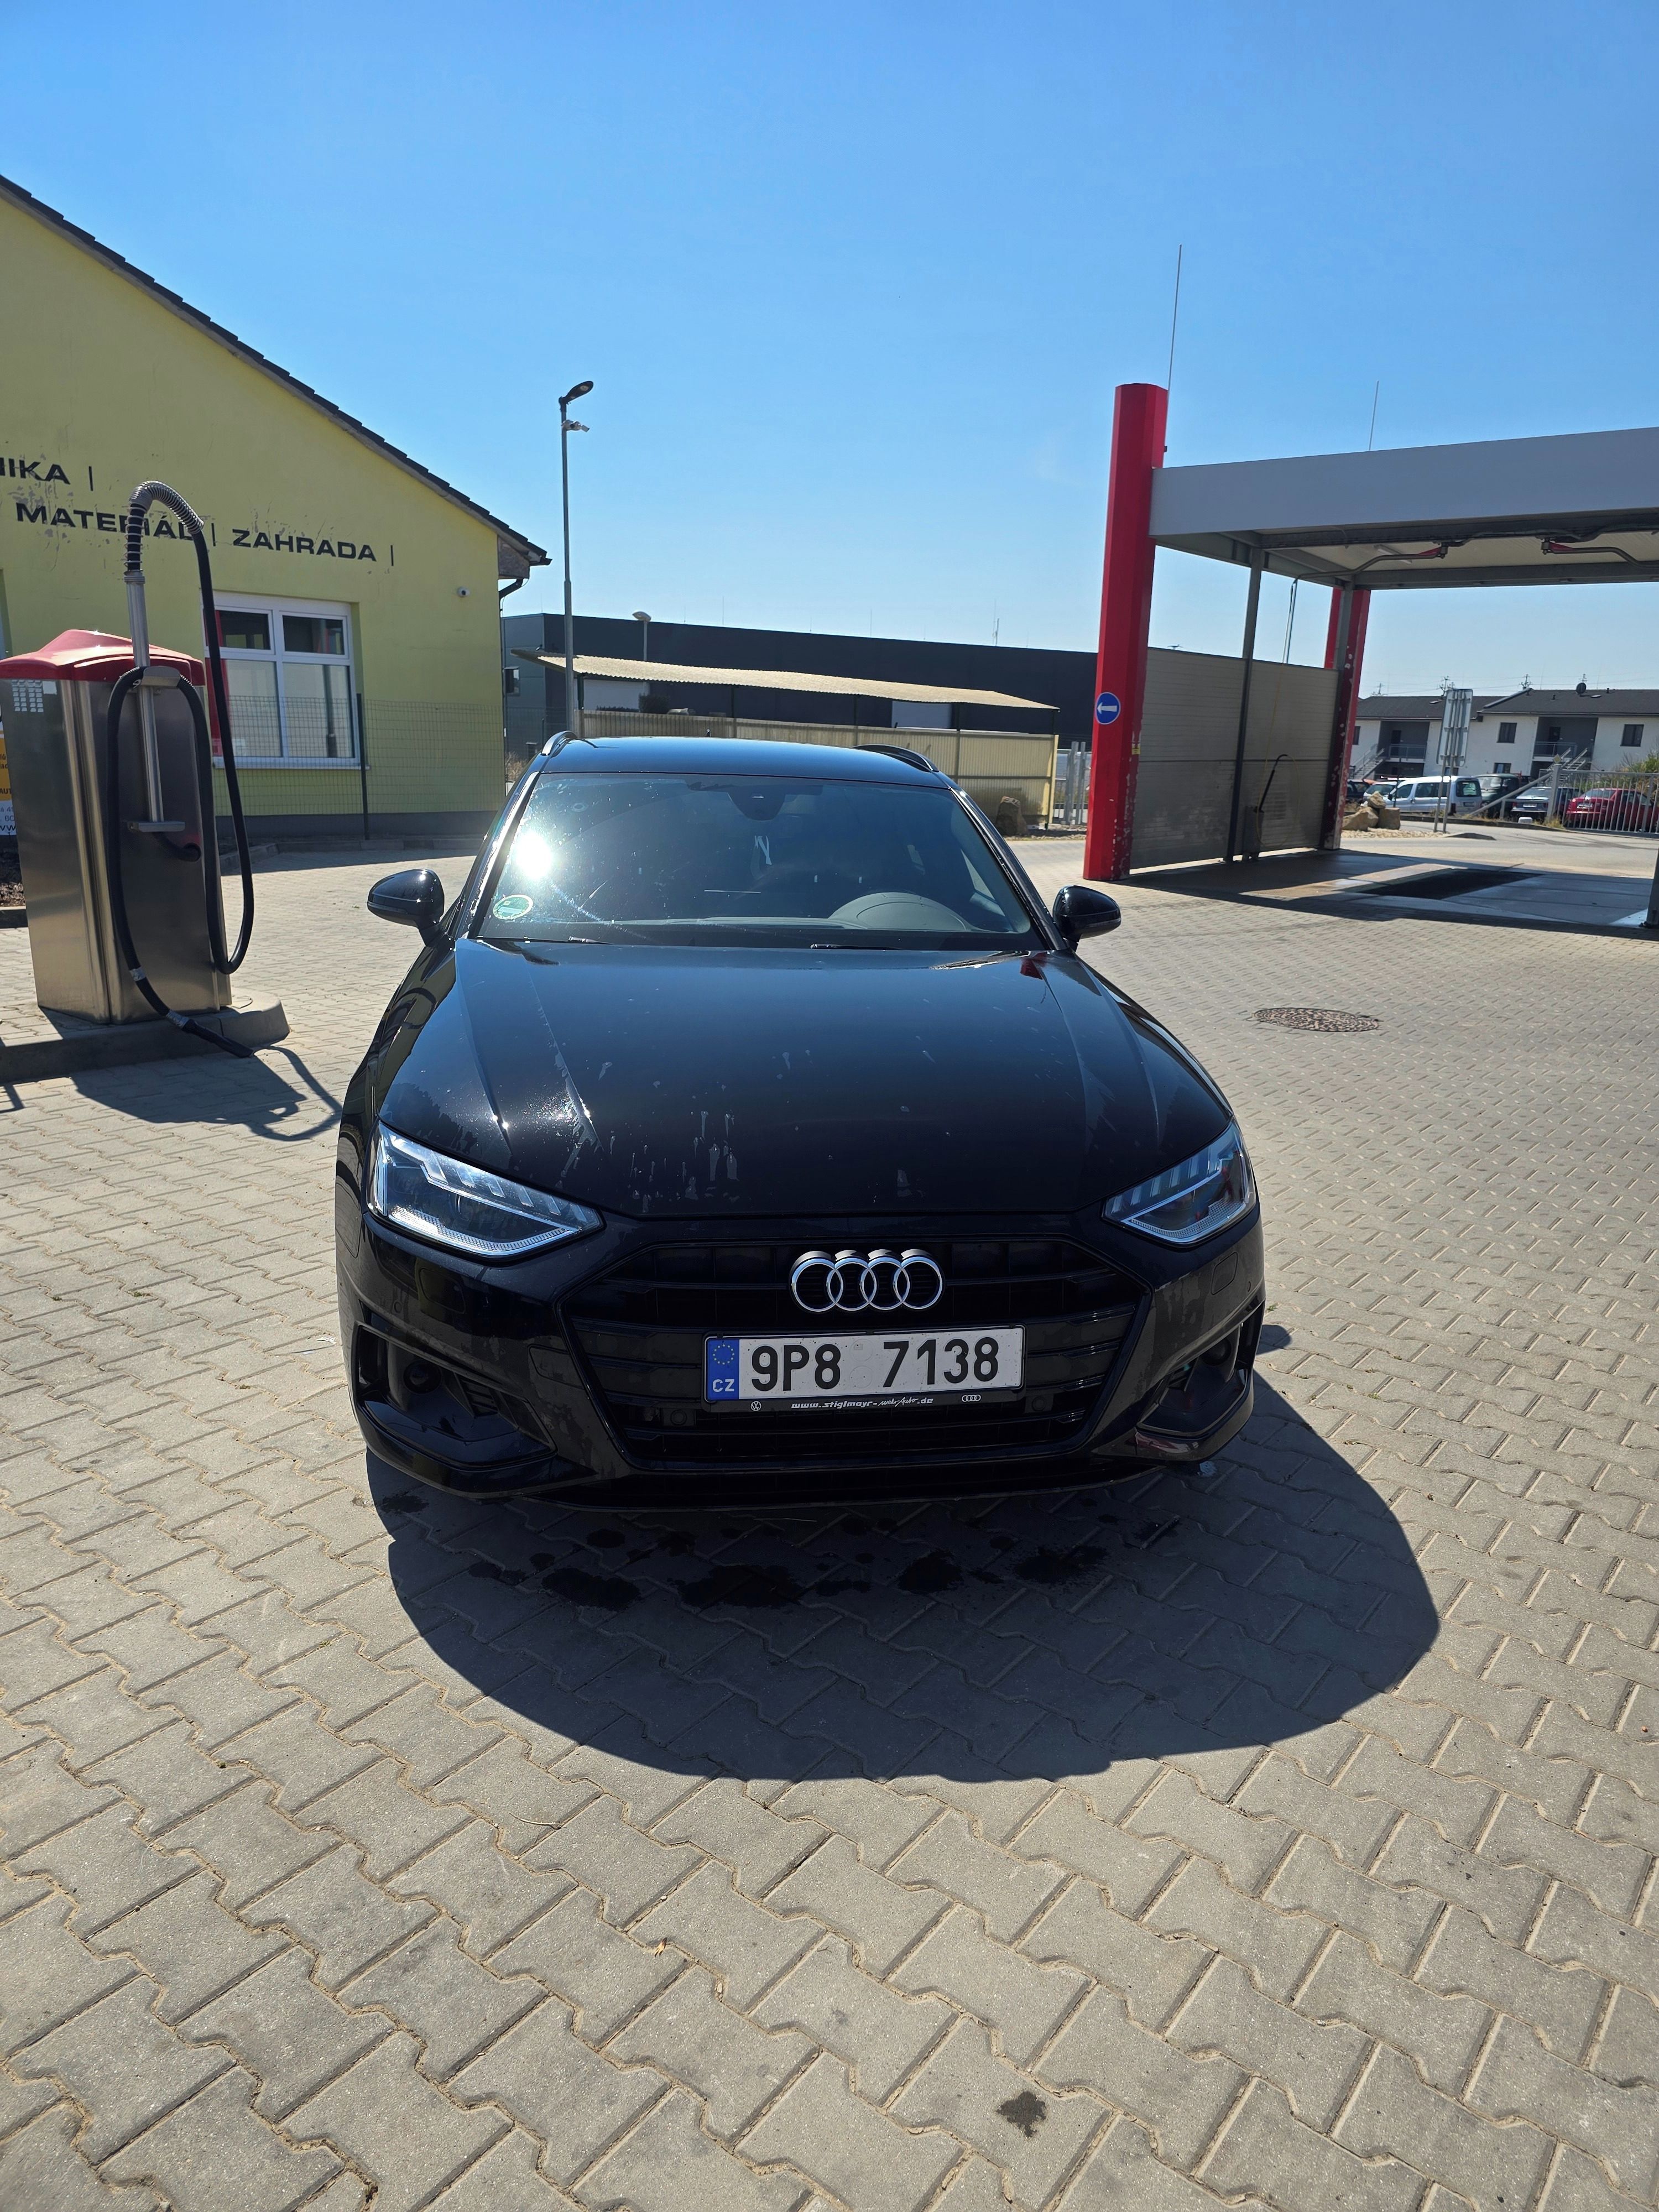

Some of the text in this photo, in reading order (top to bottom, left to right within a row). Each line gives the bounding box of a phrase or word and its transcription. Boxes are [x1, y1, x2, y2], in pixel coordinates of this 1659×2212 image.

[0, 457, 70, 484] IKA
[232, 529, 377, 561] ZAHRADA
[752, 1337, 999, 1392] 9P8 7138
[712, 1379, 735, 1392] CZ
